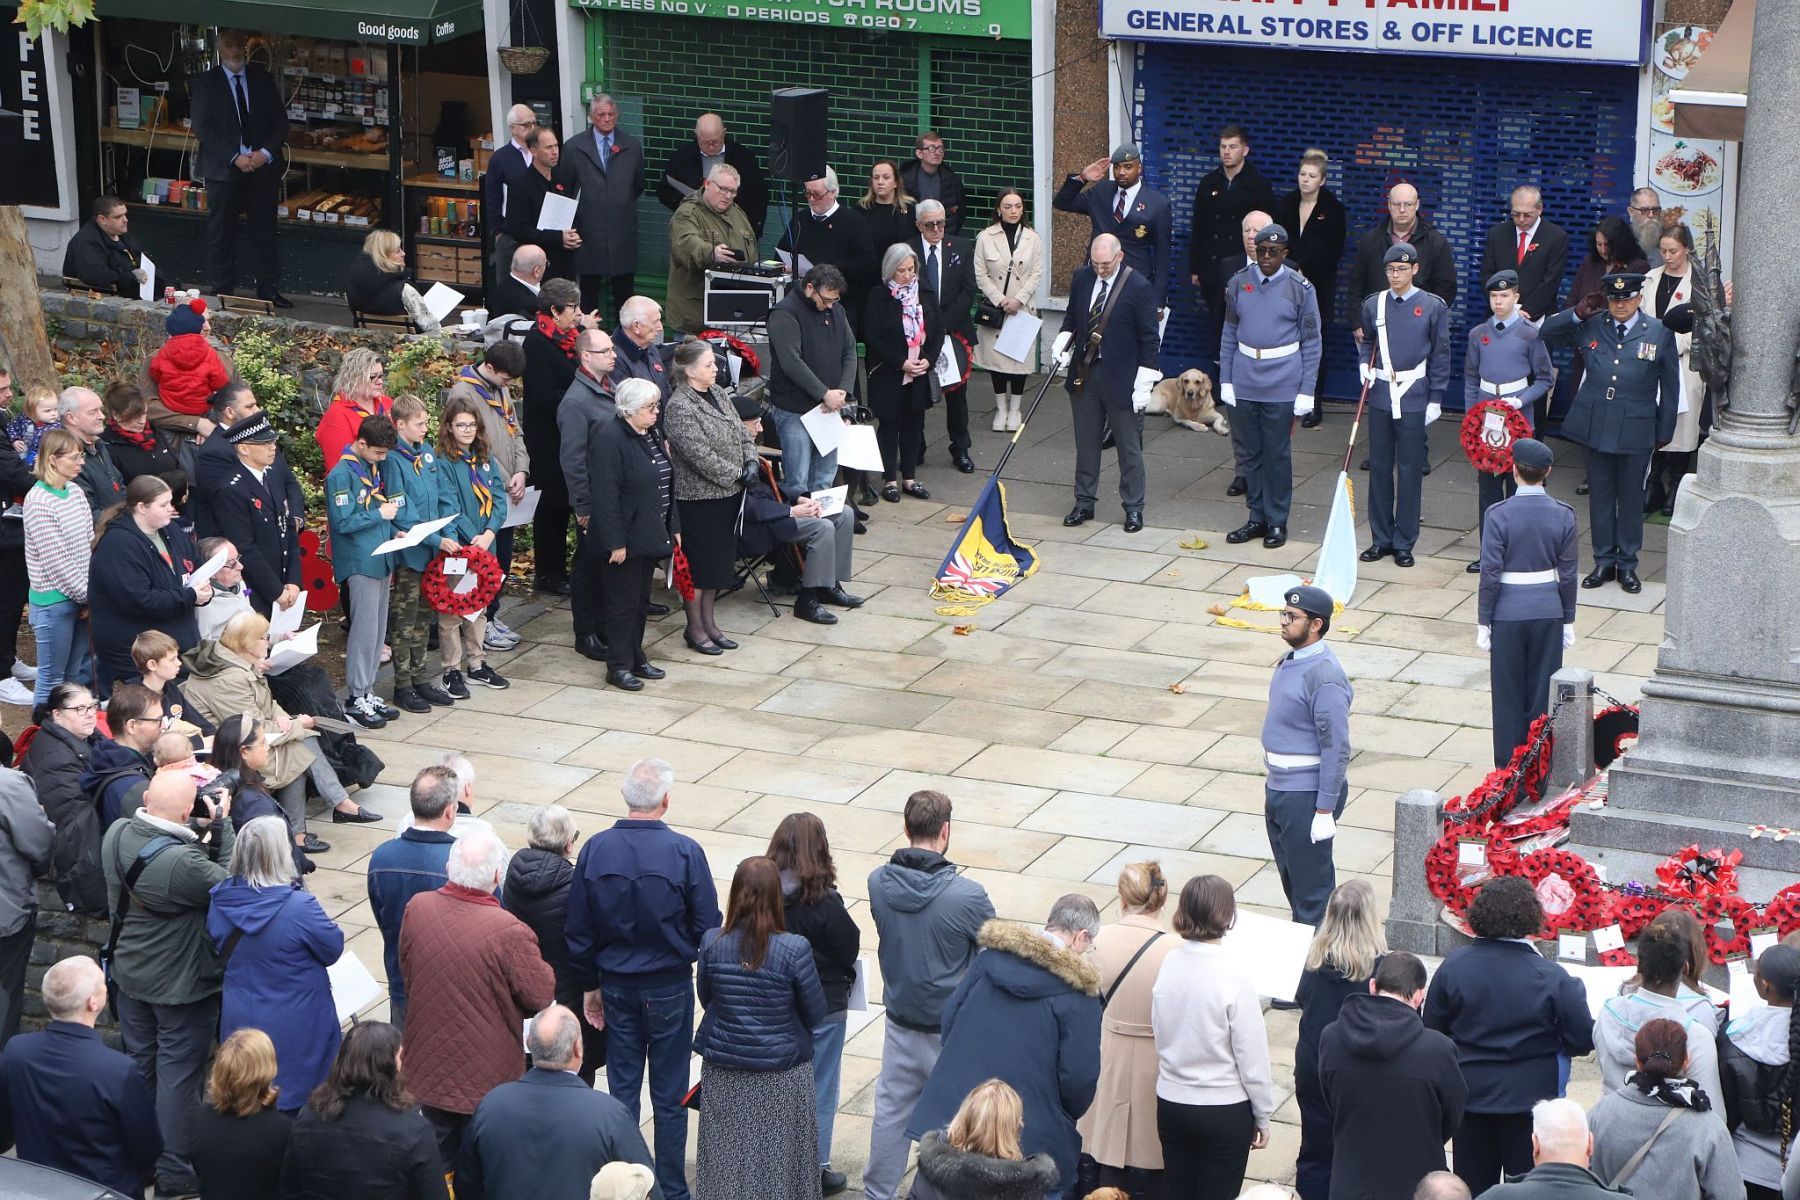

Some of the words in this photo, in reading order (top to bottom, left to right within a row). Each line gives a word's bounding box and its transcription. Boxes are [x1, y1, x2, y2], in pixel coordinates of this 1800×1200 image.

[608, 0, 655, 11] FEES
[661, 1, 688, 13] NO
[745, 6, 831, 24] PERIODS
[876, 0, 981, 16] ROOMS
[358, 21, 386, 36] Good
[387, 24, 420, 41] goods
[435, 21, 455, 38] Coffee
[1127, 9, 1252, 36] GENERAL
[1260, 16, 1369, 41] STORES
[1382, 20, 1401, 41] &
[1411, 21, 1463, 43] OFF
[1472, 24, 1593, 49] LICENCE
